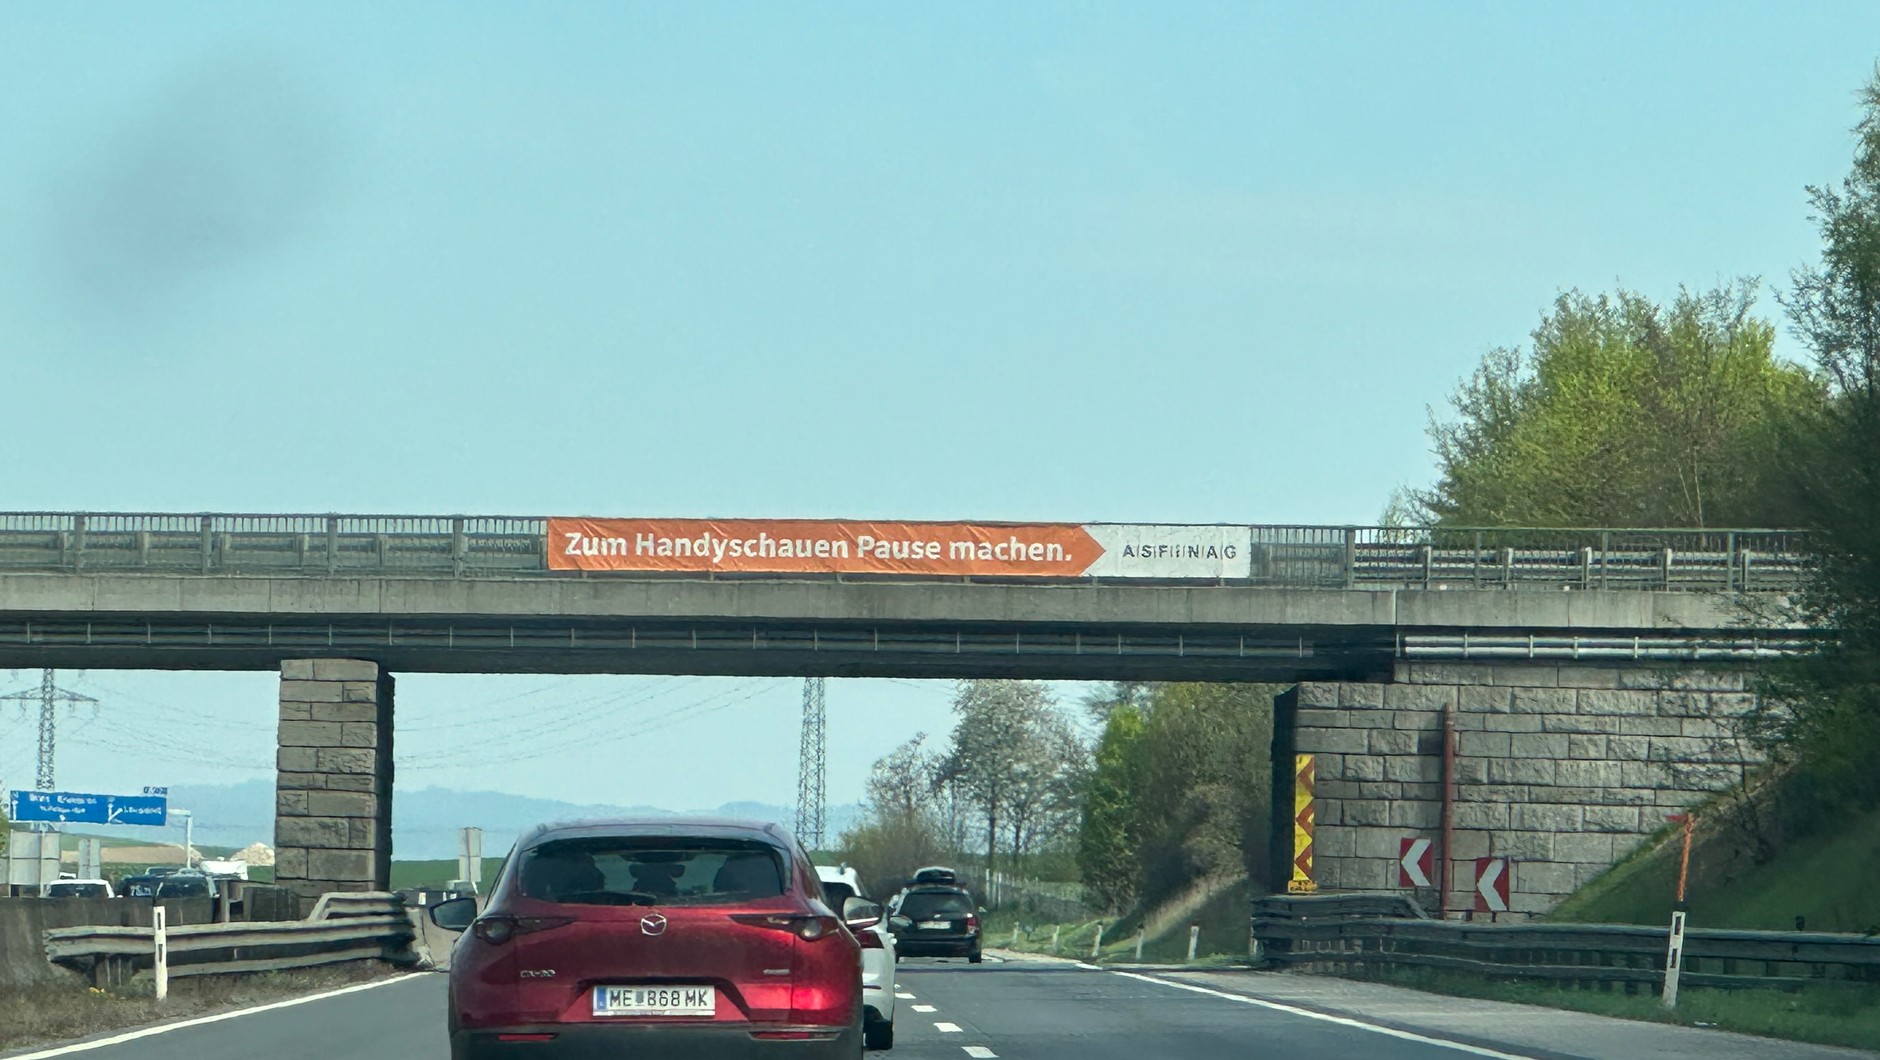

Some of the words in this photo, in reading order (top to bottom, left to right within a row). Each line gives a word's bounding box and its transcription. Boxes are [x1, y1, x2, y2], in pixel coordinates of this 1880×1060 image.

[564, 532, 627, 556] Zum
[635, 532, 849, 563] Handyschauen
[857, 535, 942, 559] Pause
[948, 536, 1072, 561] machen.
[609, 989, 632, 1007] ME
